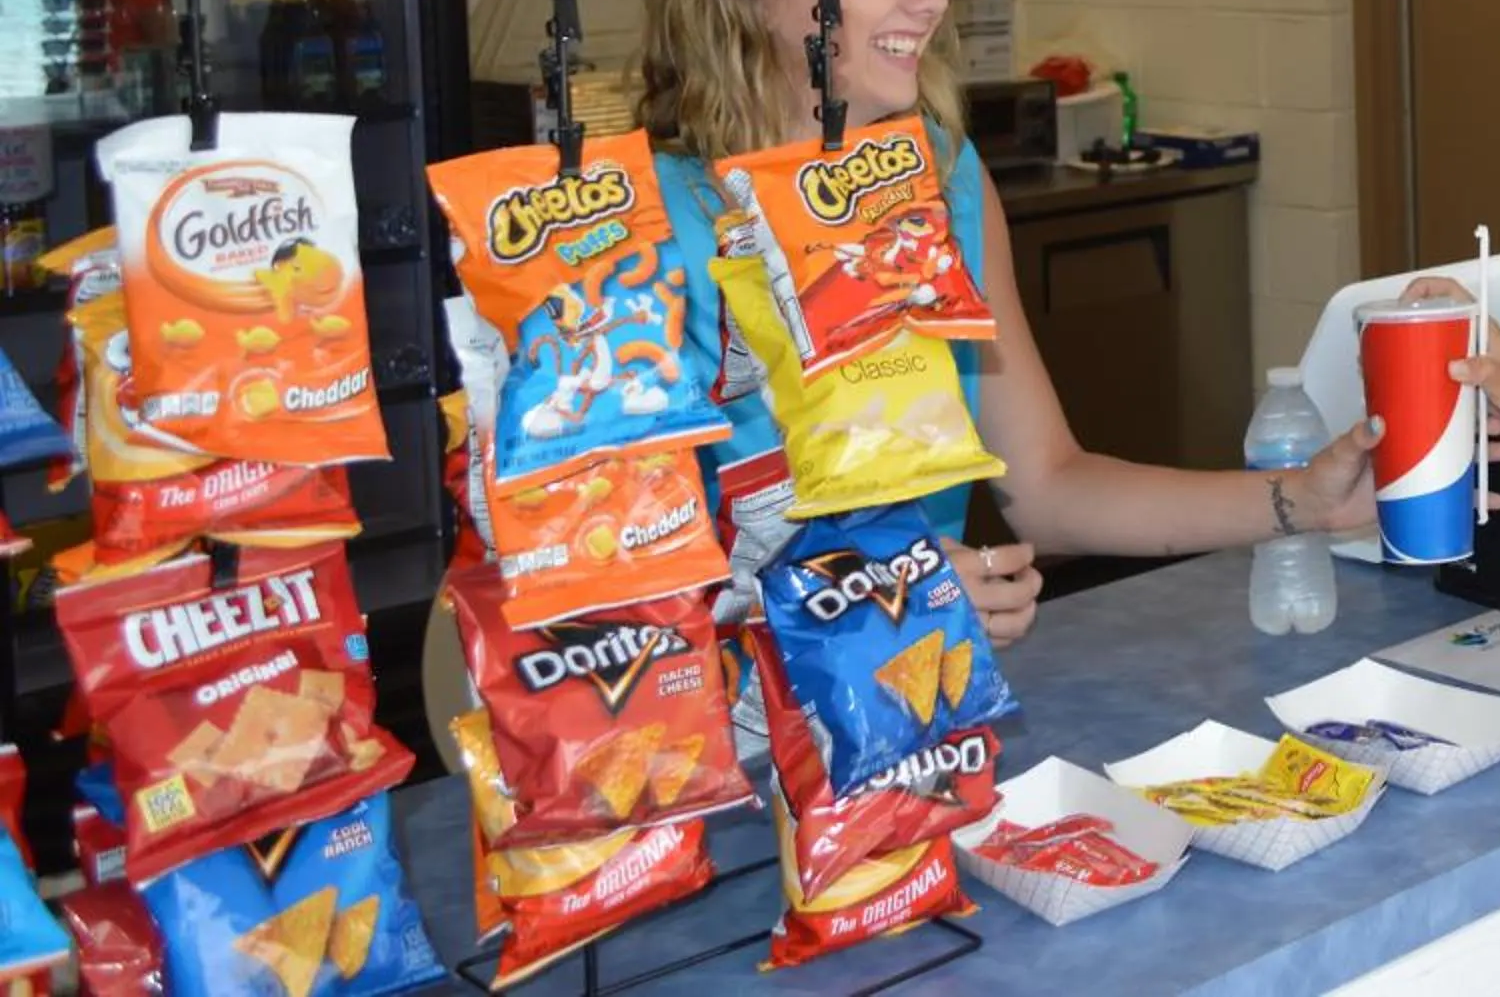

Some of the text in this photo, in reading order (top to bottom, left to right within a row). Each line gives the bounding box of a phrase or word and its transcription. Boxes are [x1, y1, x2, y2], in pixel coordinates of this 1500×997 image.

[799, 140, 921, 222] Cheetos
[174, 196, 315, 261] Goldfish
[490, 171, 631, 261] Cheetos
[285, 368, 368, 411] Cheddar
[840, 352, 927, 384] Classic
[159, 487, 197, 508] The
[620, 498, 696, 549] Cheddar
[658, 664, 702, 685] NACHO
[658, 674, 704, 696] CHEESE
[324, 831, 373, 860] RANCH
[331, 819, 368, 842] COOL
[562, 891, 591, 915] The
[595, 823, 685, 900] ORIGINAL
[830, 858, 948, 937] The ORIGINAL
